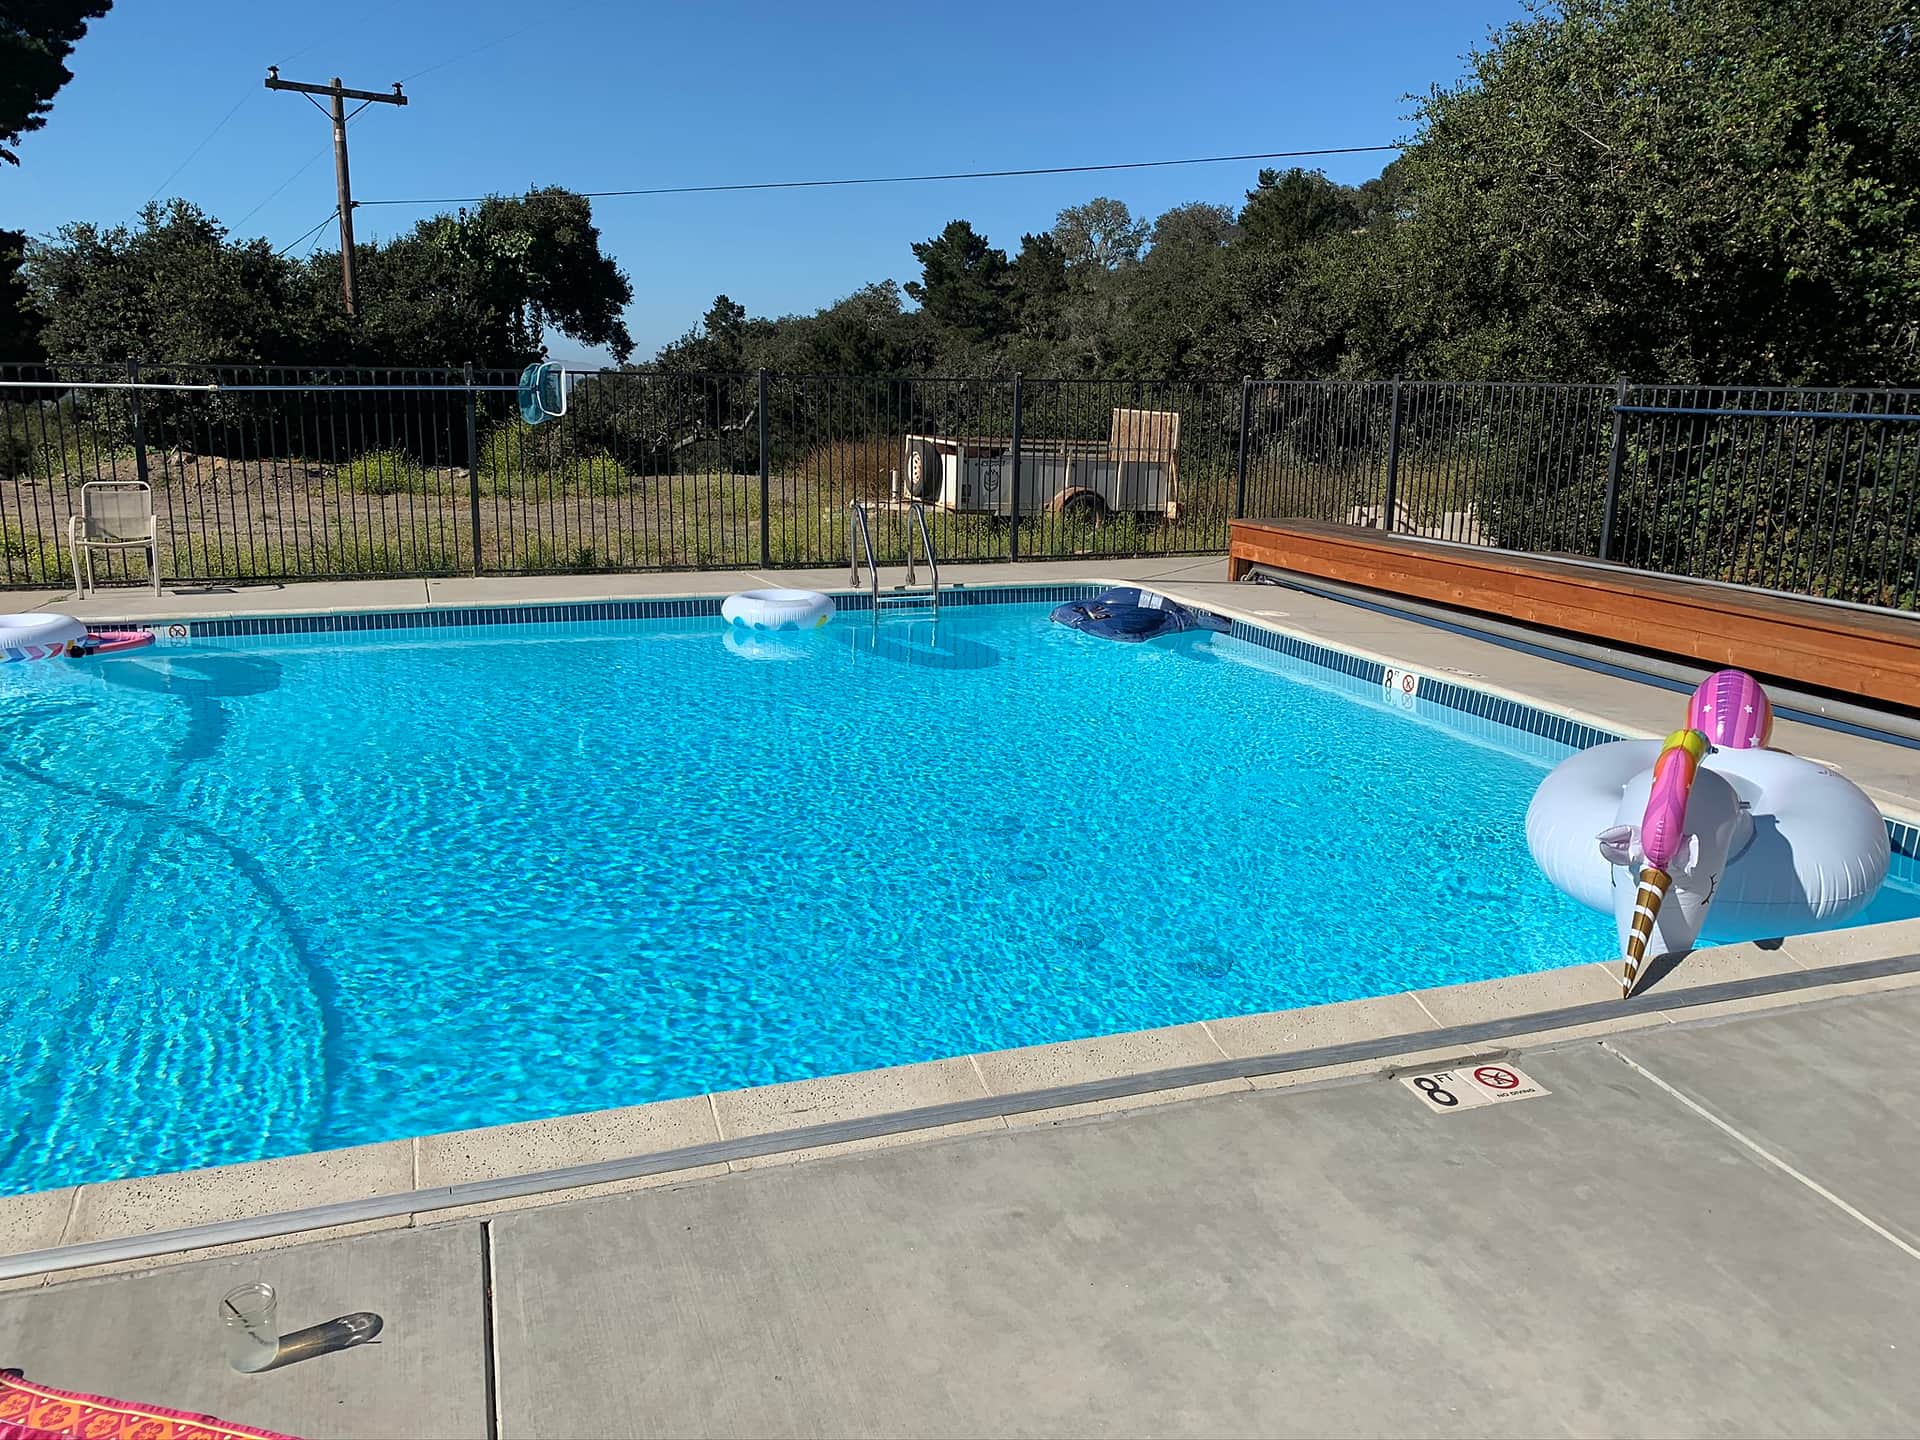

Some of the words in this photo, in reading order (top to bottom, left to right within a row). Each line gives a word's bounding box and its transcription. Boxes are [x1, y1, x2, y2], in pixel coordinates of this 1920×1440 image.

[1385, 670, 1393, 688] 8
[1433, 1073, 1453, 1083] FT
[1413, 1077, 1458, 1106] 8
[1509, 1088, 1536, 1096] DIVING
